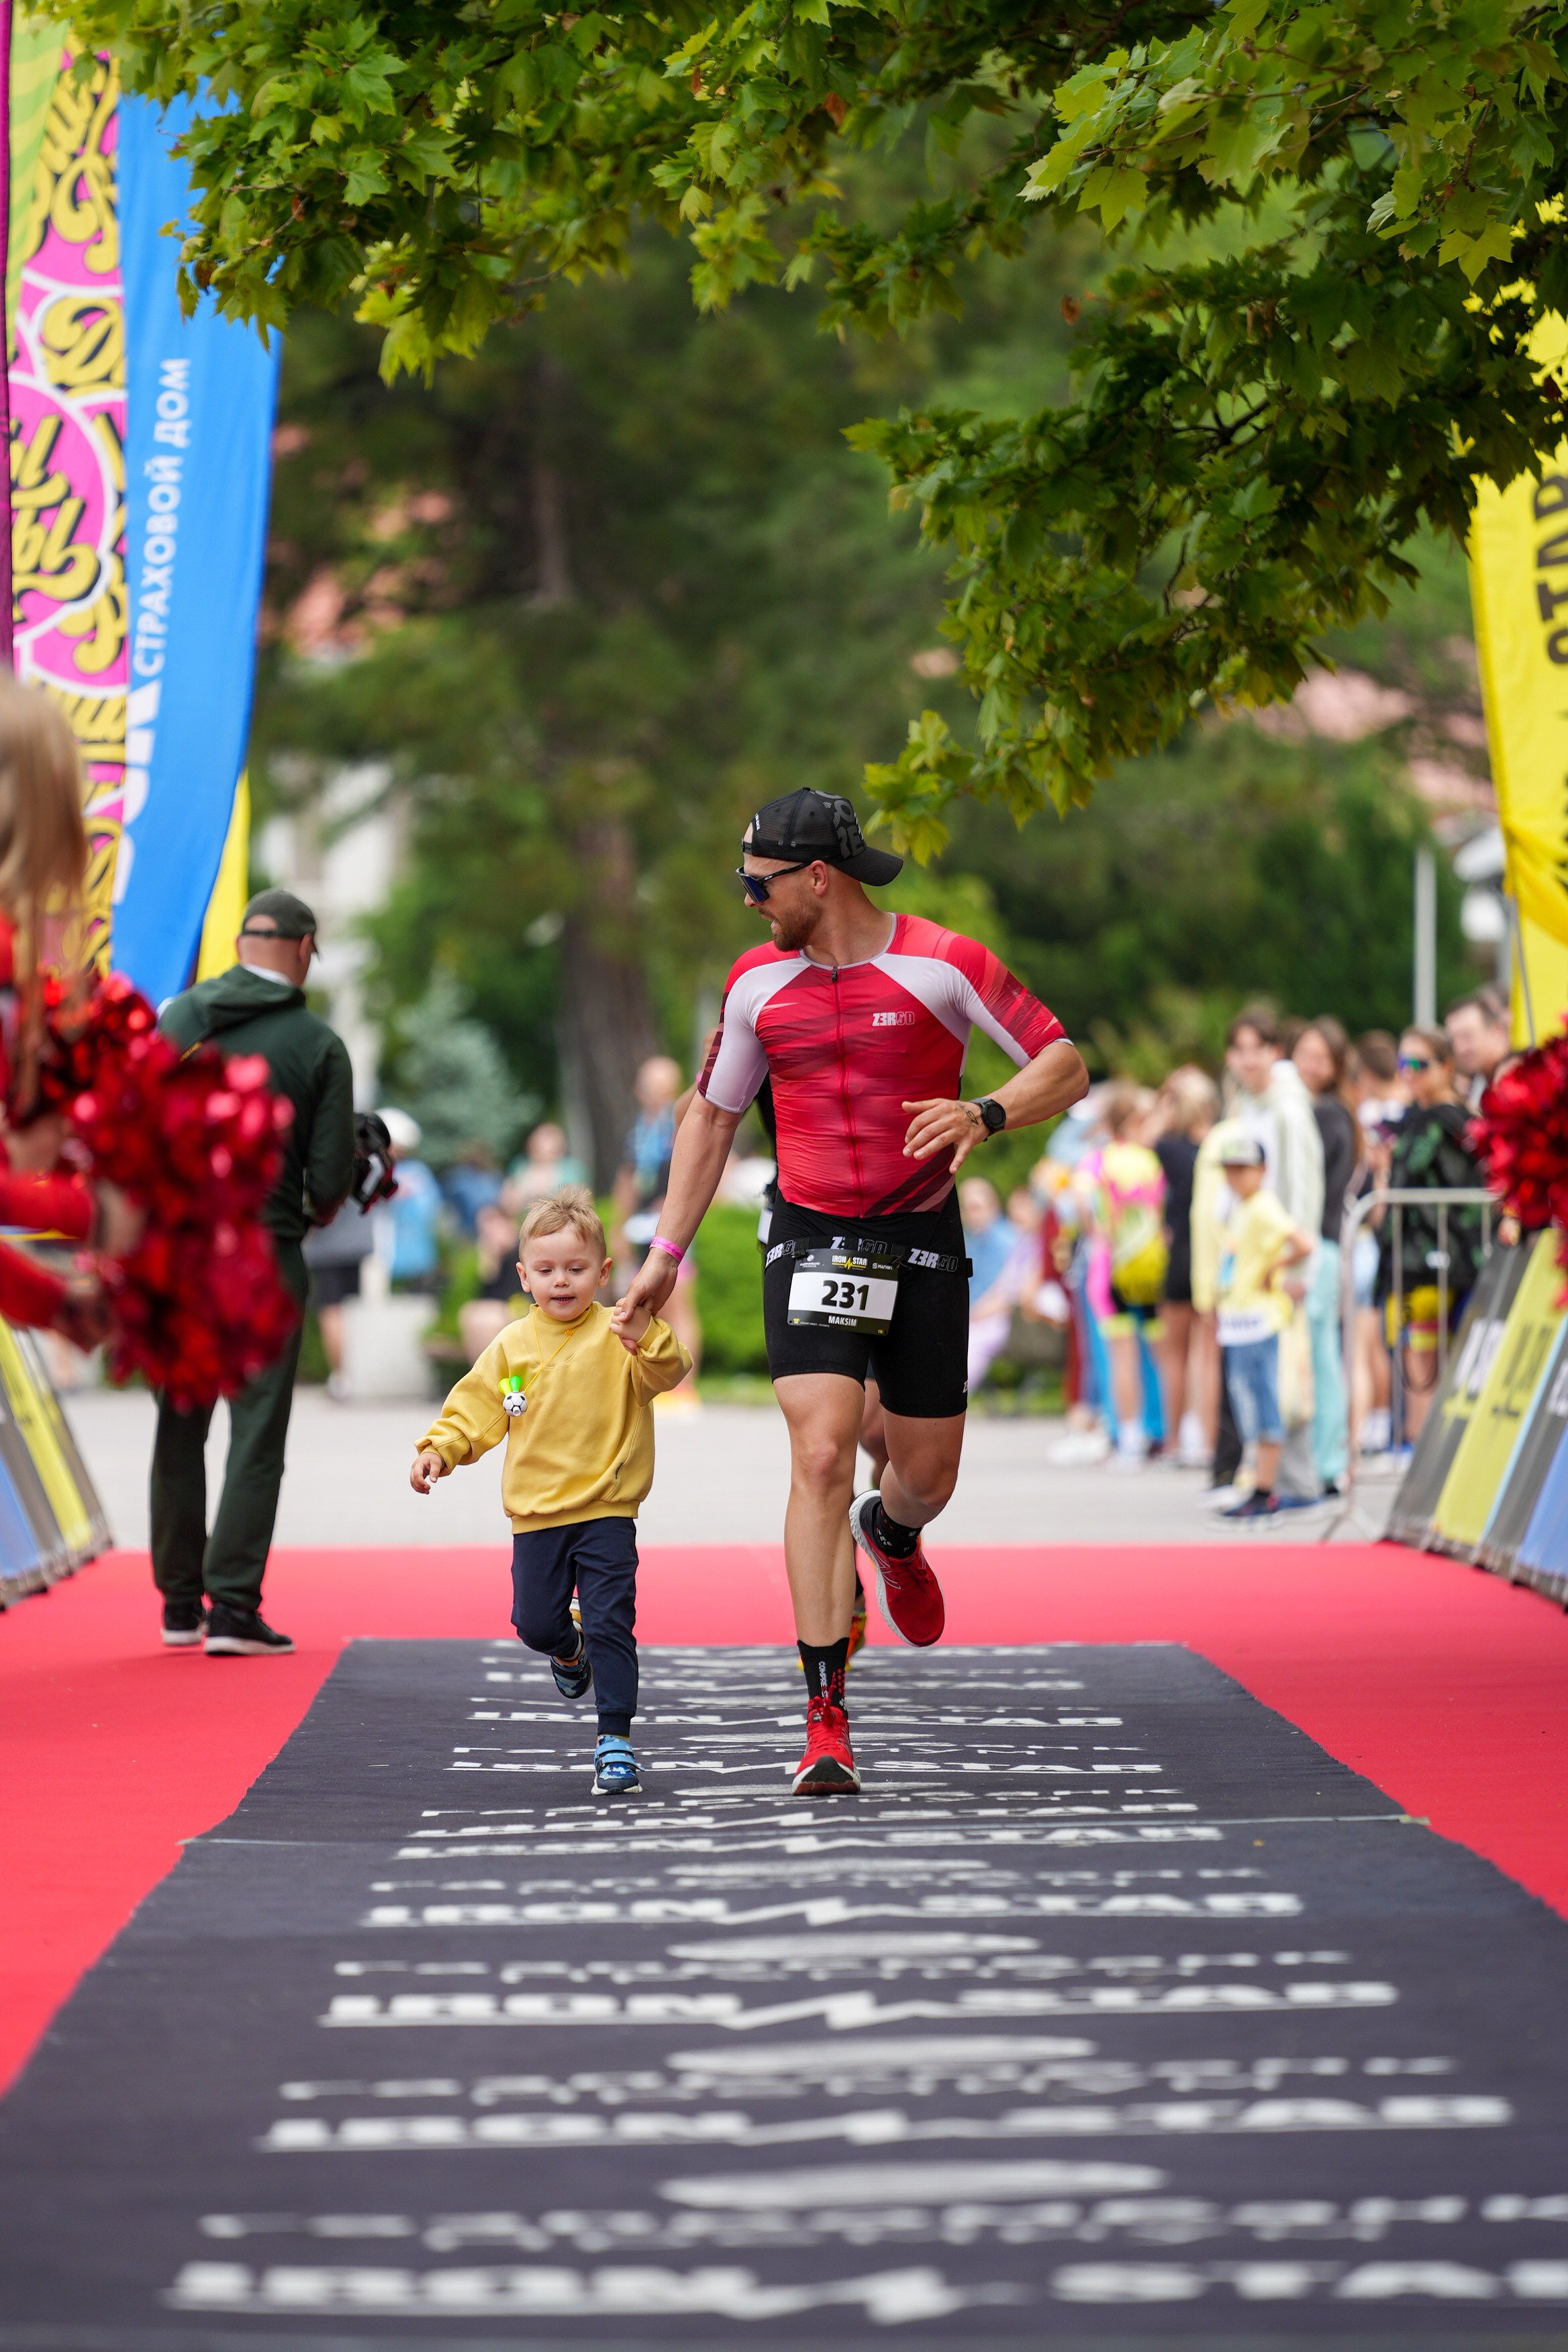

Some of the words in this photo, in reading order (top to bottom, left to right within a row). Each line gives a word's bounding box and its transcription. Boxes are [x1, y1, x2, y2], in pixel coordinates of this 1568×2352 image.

[154, 357, 193, 449] ДОМ
[132, 454, 184, 678] СТРАХОВОЙ
[832, 1255, 846, 1263] IRON
[852, 1257, 867, 1266] STAR
[821, 1280, 869, 1311] 231
[828, 1316, 857, 1327] MAKSIM
[858, 1715, 1122, 1725] STAR
[872, 1761, 1163, 1771] STAR
[412, 1815, 714, 1836] IRON
[878, 1803, 1197, 1819] STAR
[396, 1838, 713, 1859] IRON
[886, 1826, 1223, 1844] STAR
